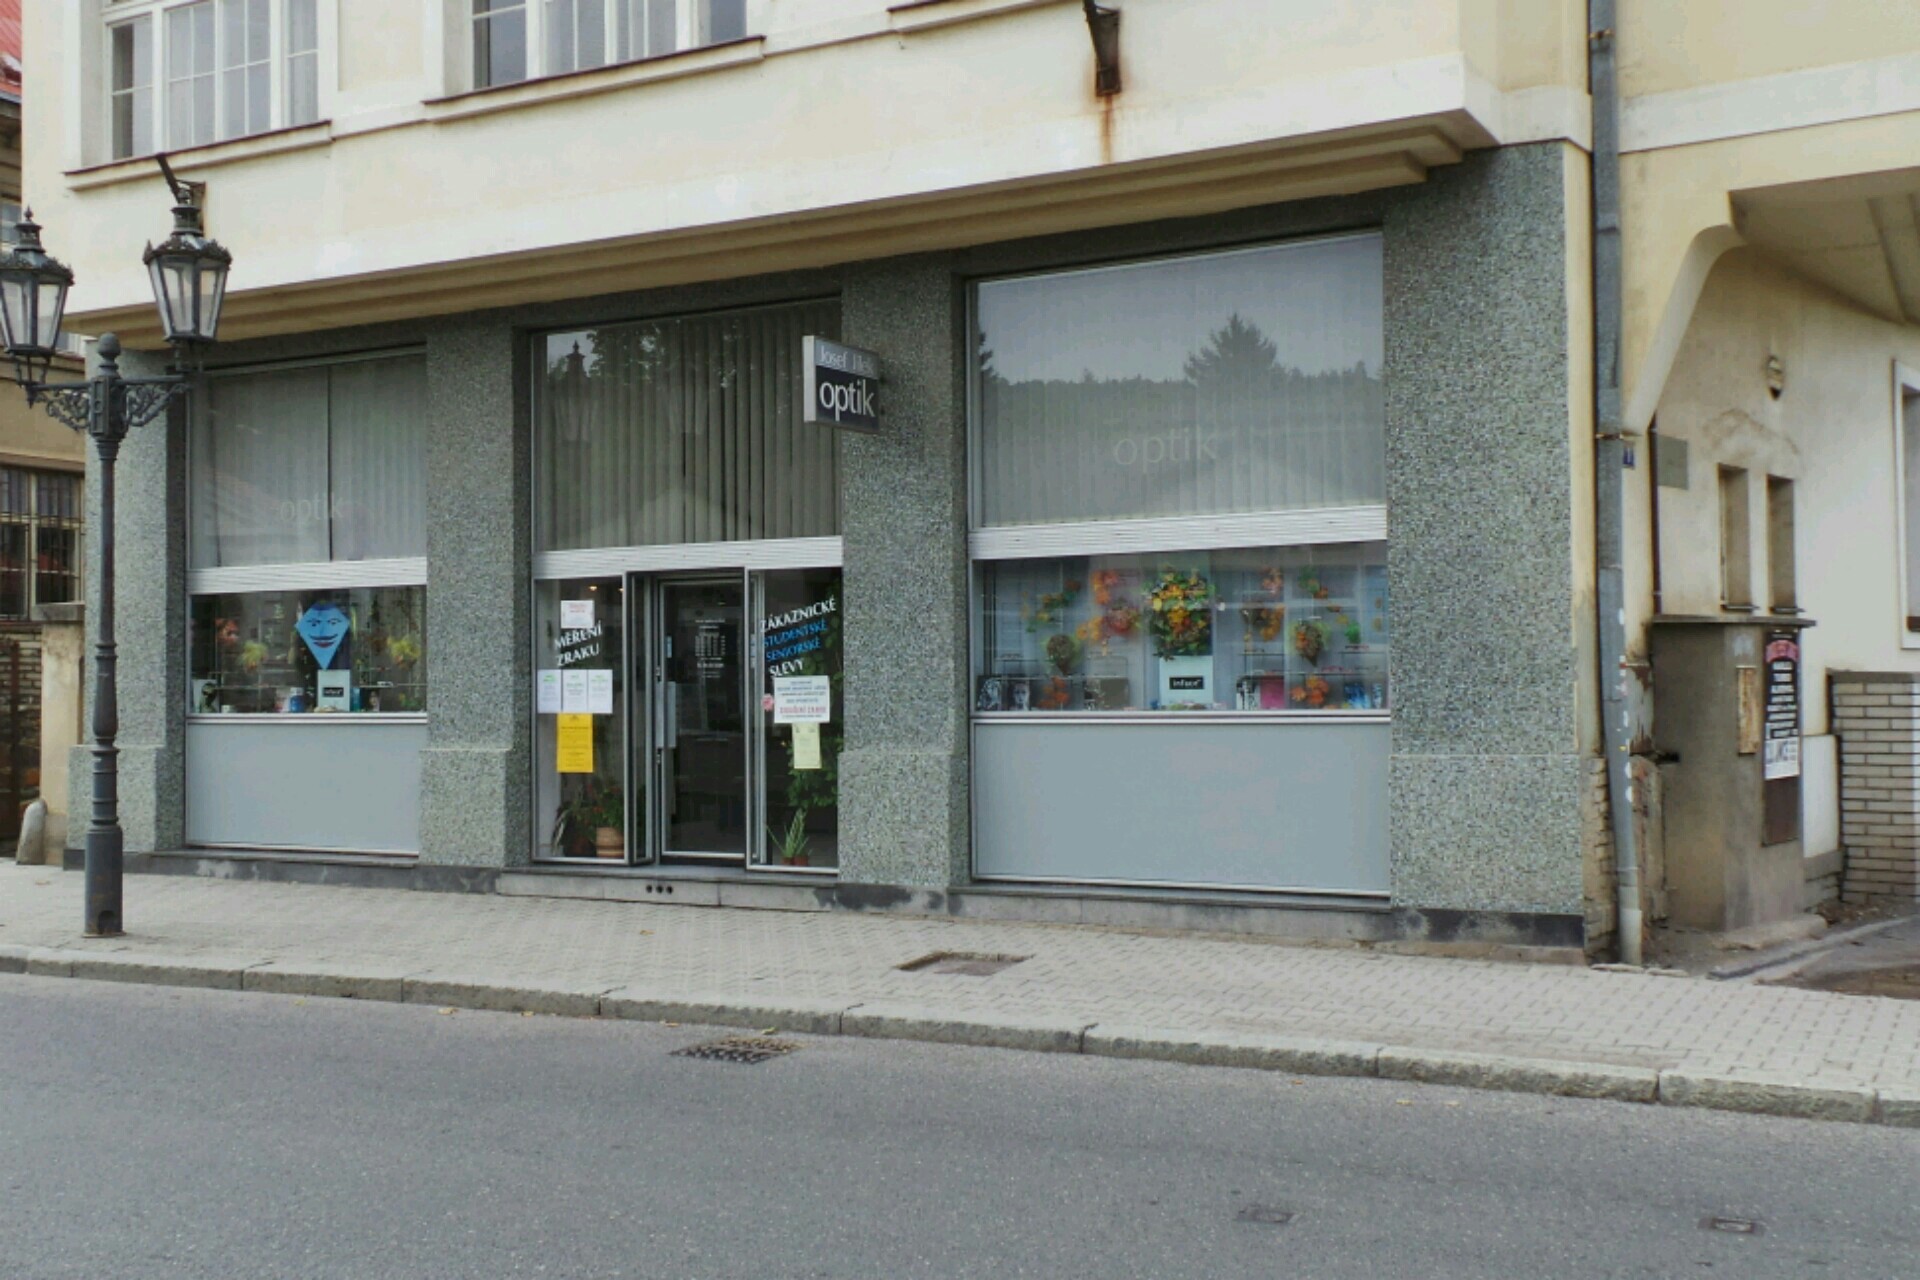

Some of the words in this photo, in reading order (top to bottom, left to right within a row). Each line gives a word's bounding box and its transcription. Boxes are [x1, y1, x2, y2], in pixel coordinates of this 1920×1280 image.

[820, 379, 875, 421] optik
[1113, 424, 1217, 473] optik
[760, 595, 836, 632] ZÁKAZNICKÉ
[763, 618, 827, 647] STUDENTSKÉ
[556, 642, 599, 666] ZRAKU
[769, 659, 803, 676] SLEVY
